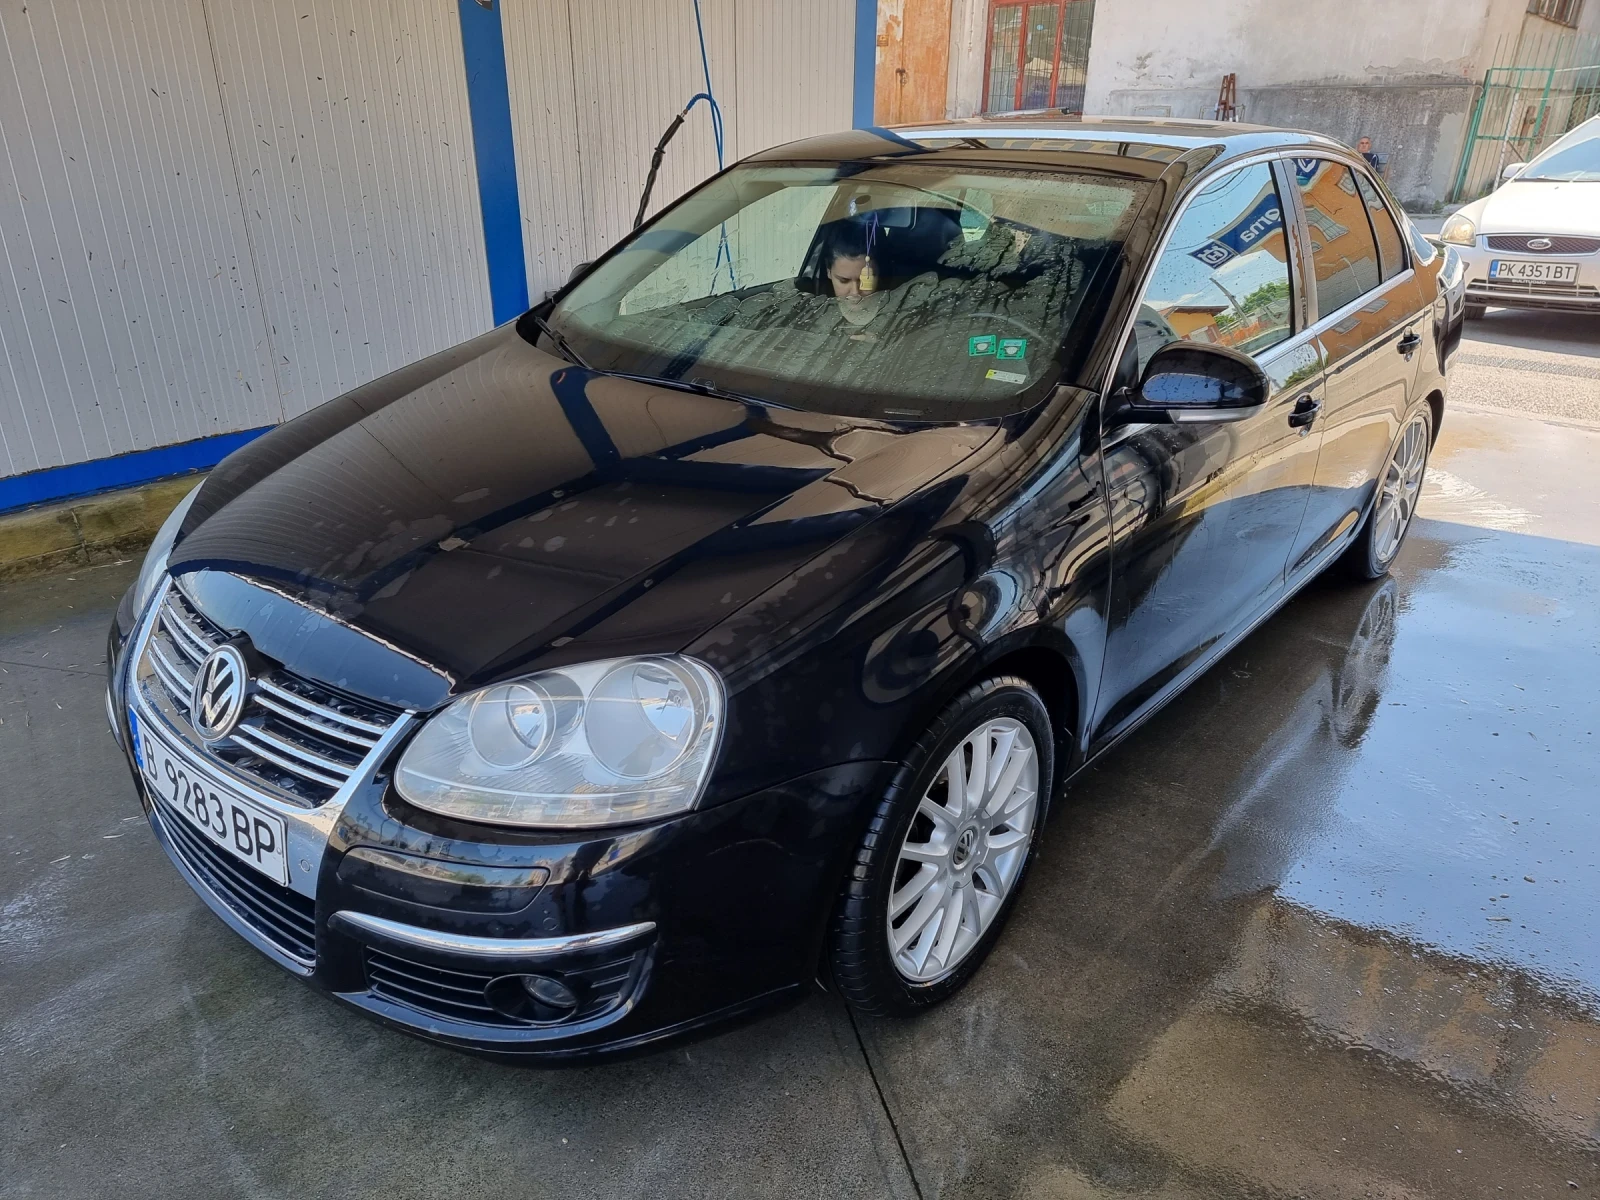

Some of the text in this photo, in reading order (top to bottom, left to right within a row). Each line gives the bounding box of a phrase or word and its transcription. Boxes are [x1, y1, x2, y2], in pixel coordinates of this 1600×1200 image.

[1498, 263, 1574, 280] PK 4351 BT
[144, 734, 275, 864] B 9283 BP
